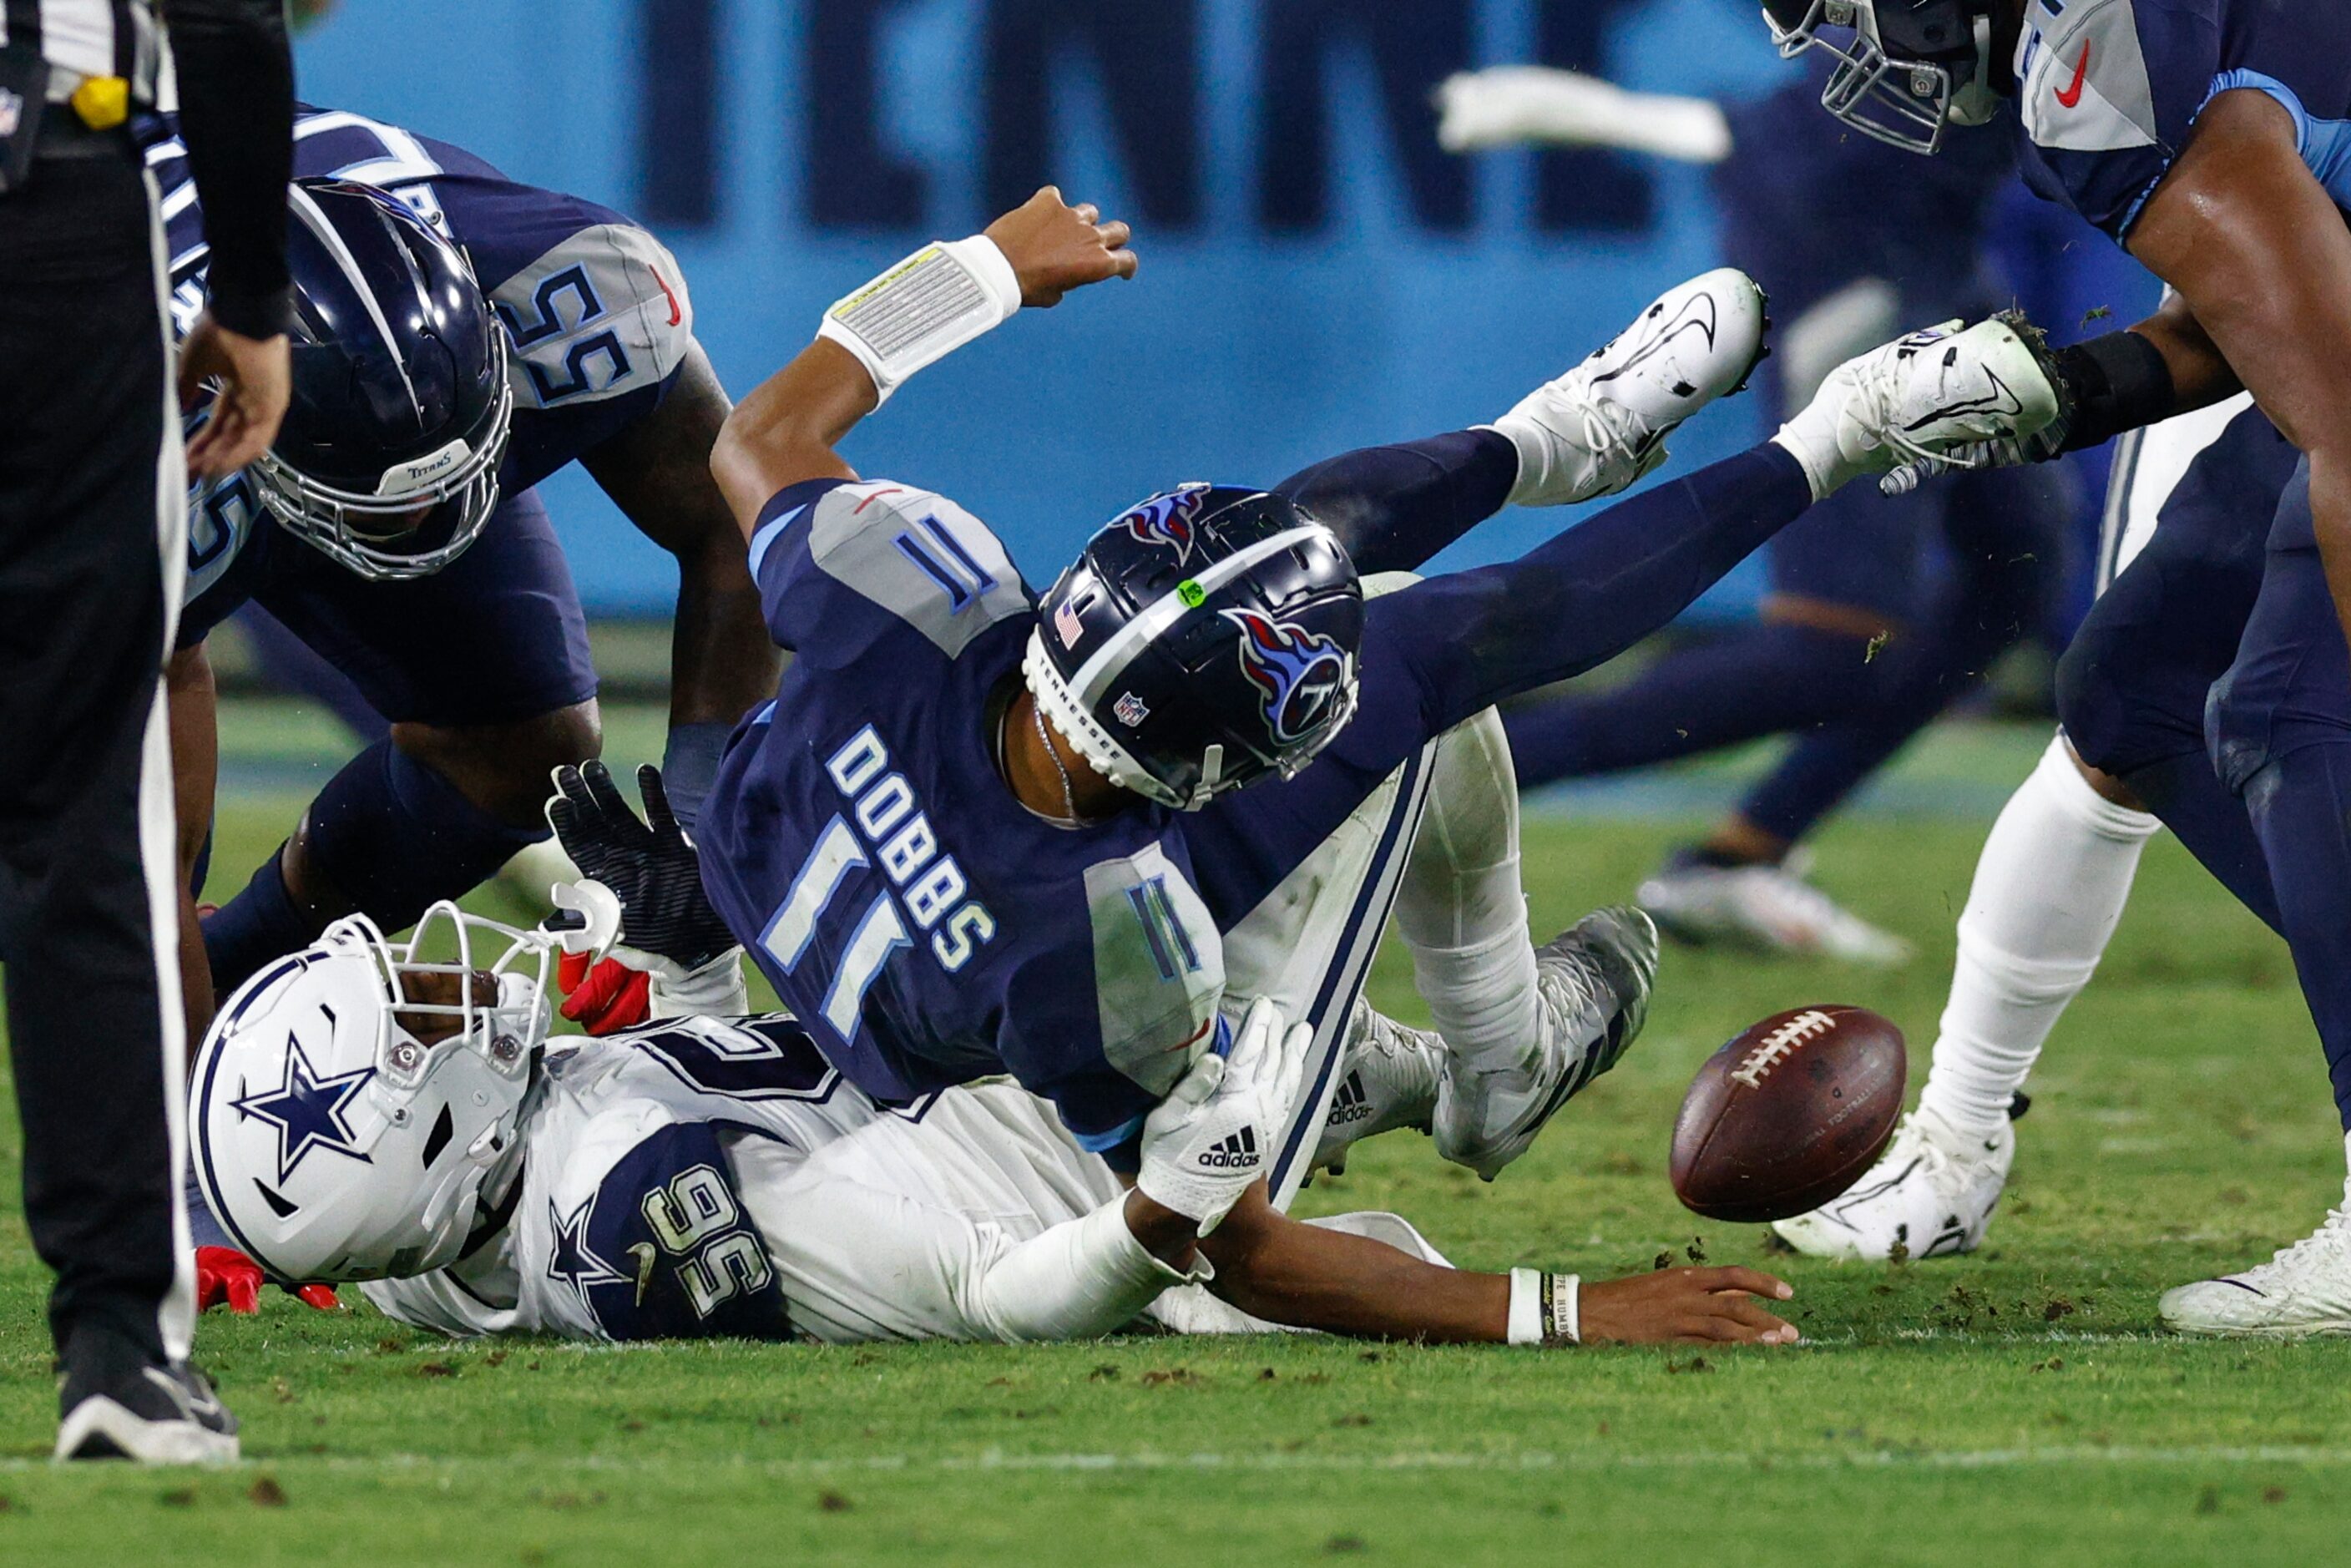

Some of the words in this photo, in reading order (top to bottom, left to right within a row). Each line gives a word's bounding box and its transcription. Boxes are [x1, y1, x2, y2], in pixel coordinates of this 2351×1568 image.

[506, 261, 632, 409] 55
[892, 513, 999, 616] 11
[1038, 657, 1121, 761] TENNESSEE
[1117, 703, 1141, 723] NFL
[825, 722, 997, 973] DOBBS
[756, 812, 913, 1045] 11
[1125, 873, 1203, 984] 11
[1198, 1151, 1261, 1168] adidas
[640, 1161, 774, 1321] 56
